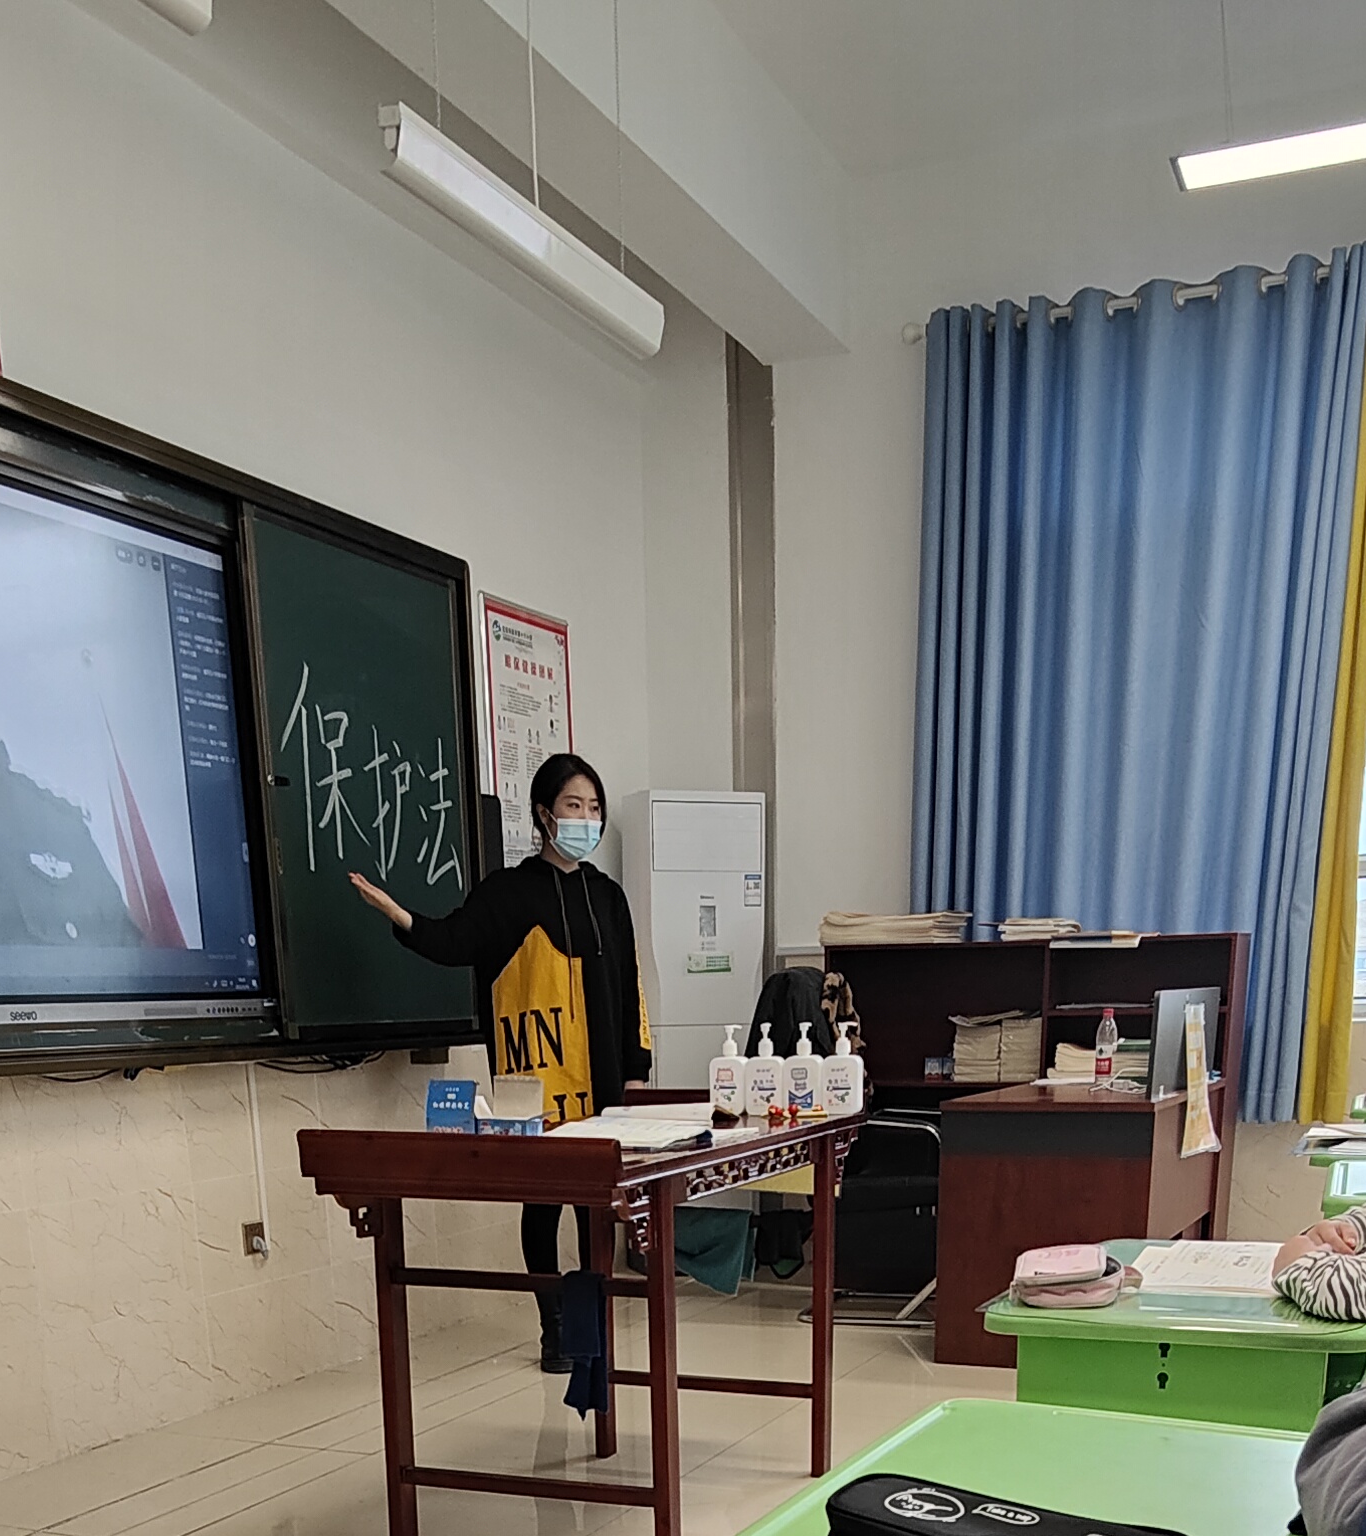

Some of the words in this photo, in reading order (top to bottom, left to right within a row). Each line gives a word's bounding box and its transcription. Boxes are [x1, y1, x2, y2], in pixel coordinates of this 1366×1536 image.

[280, 662, 463, 891] 保护法
[9, 1010, 38, 1022] seewo
[500, 1007, 564, 1075] MN
